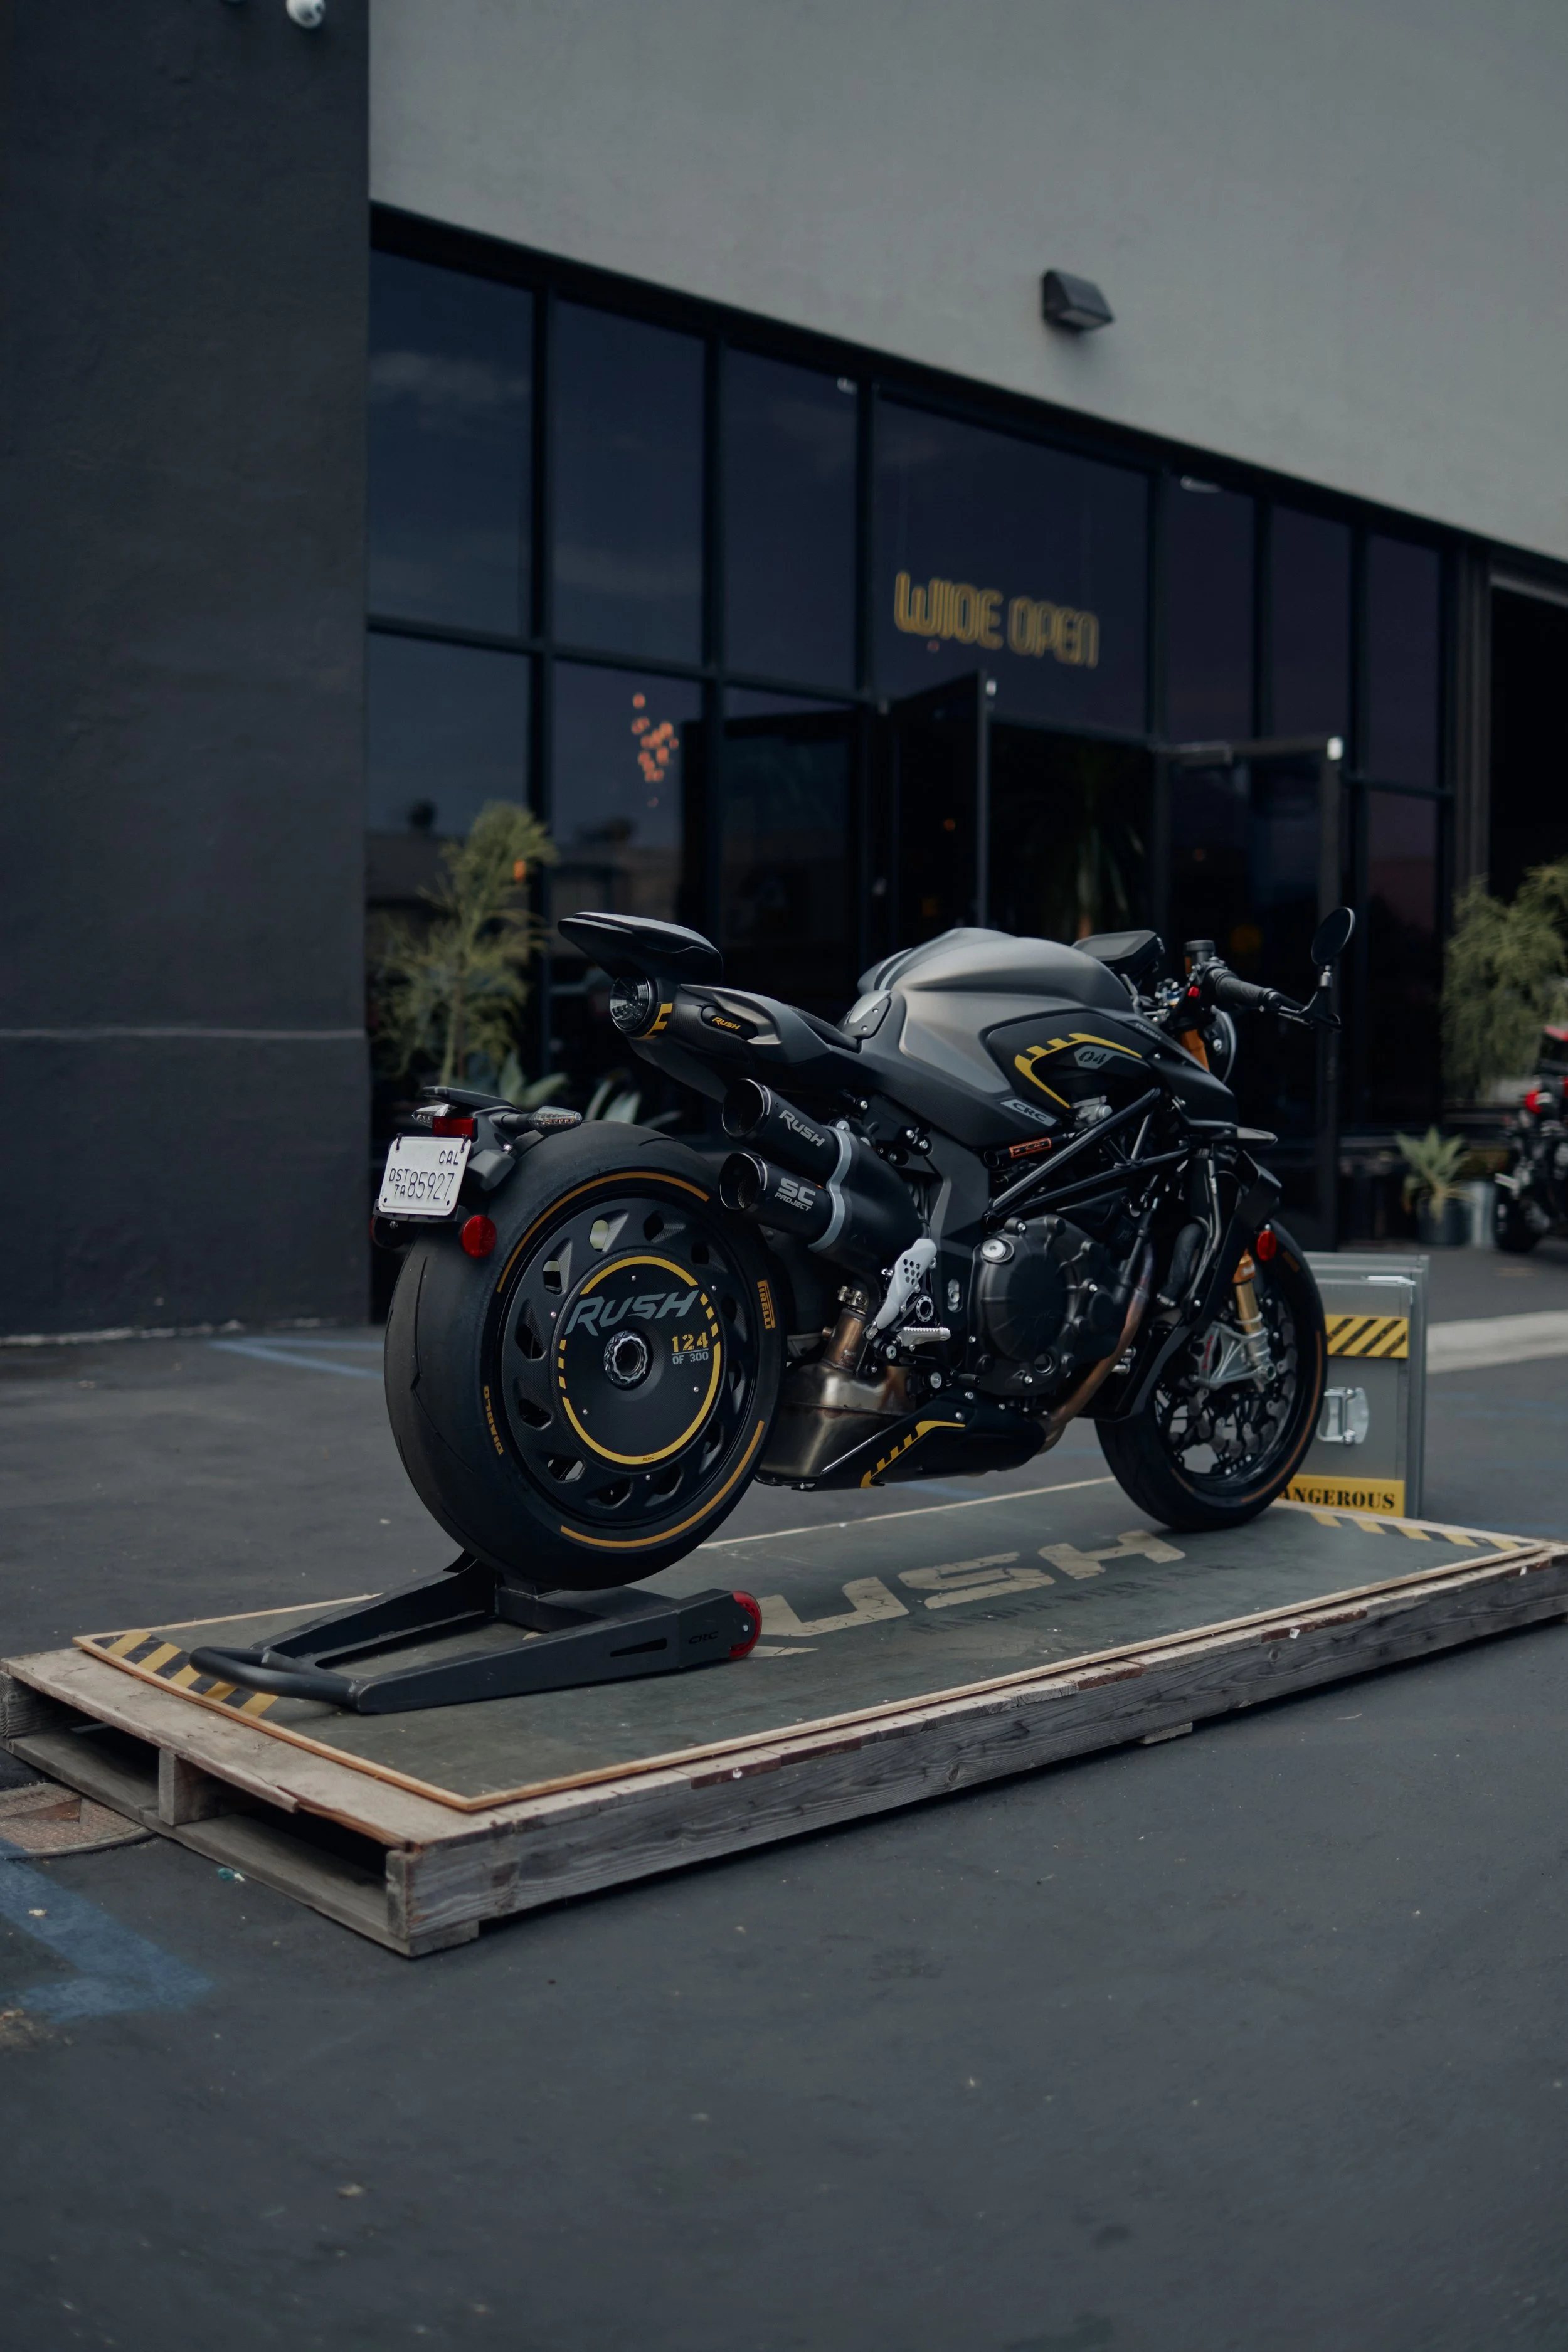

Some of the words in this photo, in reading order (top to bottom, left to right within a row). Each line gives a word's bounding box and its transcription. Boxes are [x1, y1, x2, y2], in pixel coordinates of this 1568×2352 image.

[894, 571, 1003, 650] WIDE
[1007, 596, 1099, 669] OPEN
[712, 1016, 741, 1030] RUSH
[1012, 1102, 1047, 1122] CRC
[778, 1109, 825, 1147] RUSH
[438, 1150, 458, 1165] CAL
[389, 1168, 410, 1182] DST
[408, 1171, 455, 1200] 85927
[775, 1192, 811, 1212] PROJECT
[778, 1177, 816, 1206] SC
[564, 1290, 700, 1337] RUSH
[757, 1279, 776, 1330] PIRELLI
[672, 1332, 709, 1353] 124
[672, 1354, 684, 1365] OF
[690, 1351, 709, 1362] 300
[484, 1385, 504, 1455] DIABLO
[1280, 1487, 1395, 1510] ANGEROUS
[751, 1528, 1187, 1657] USH
[689, 1631, 719, 1645] CRC
